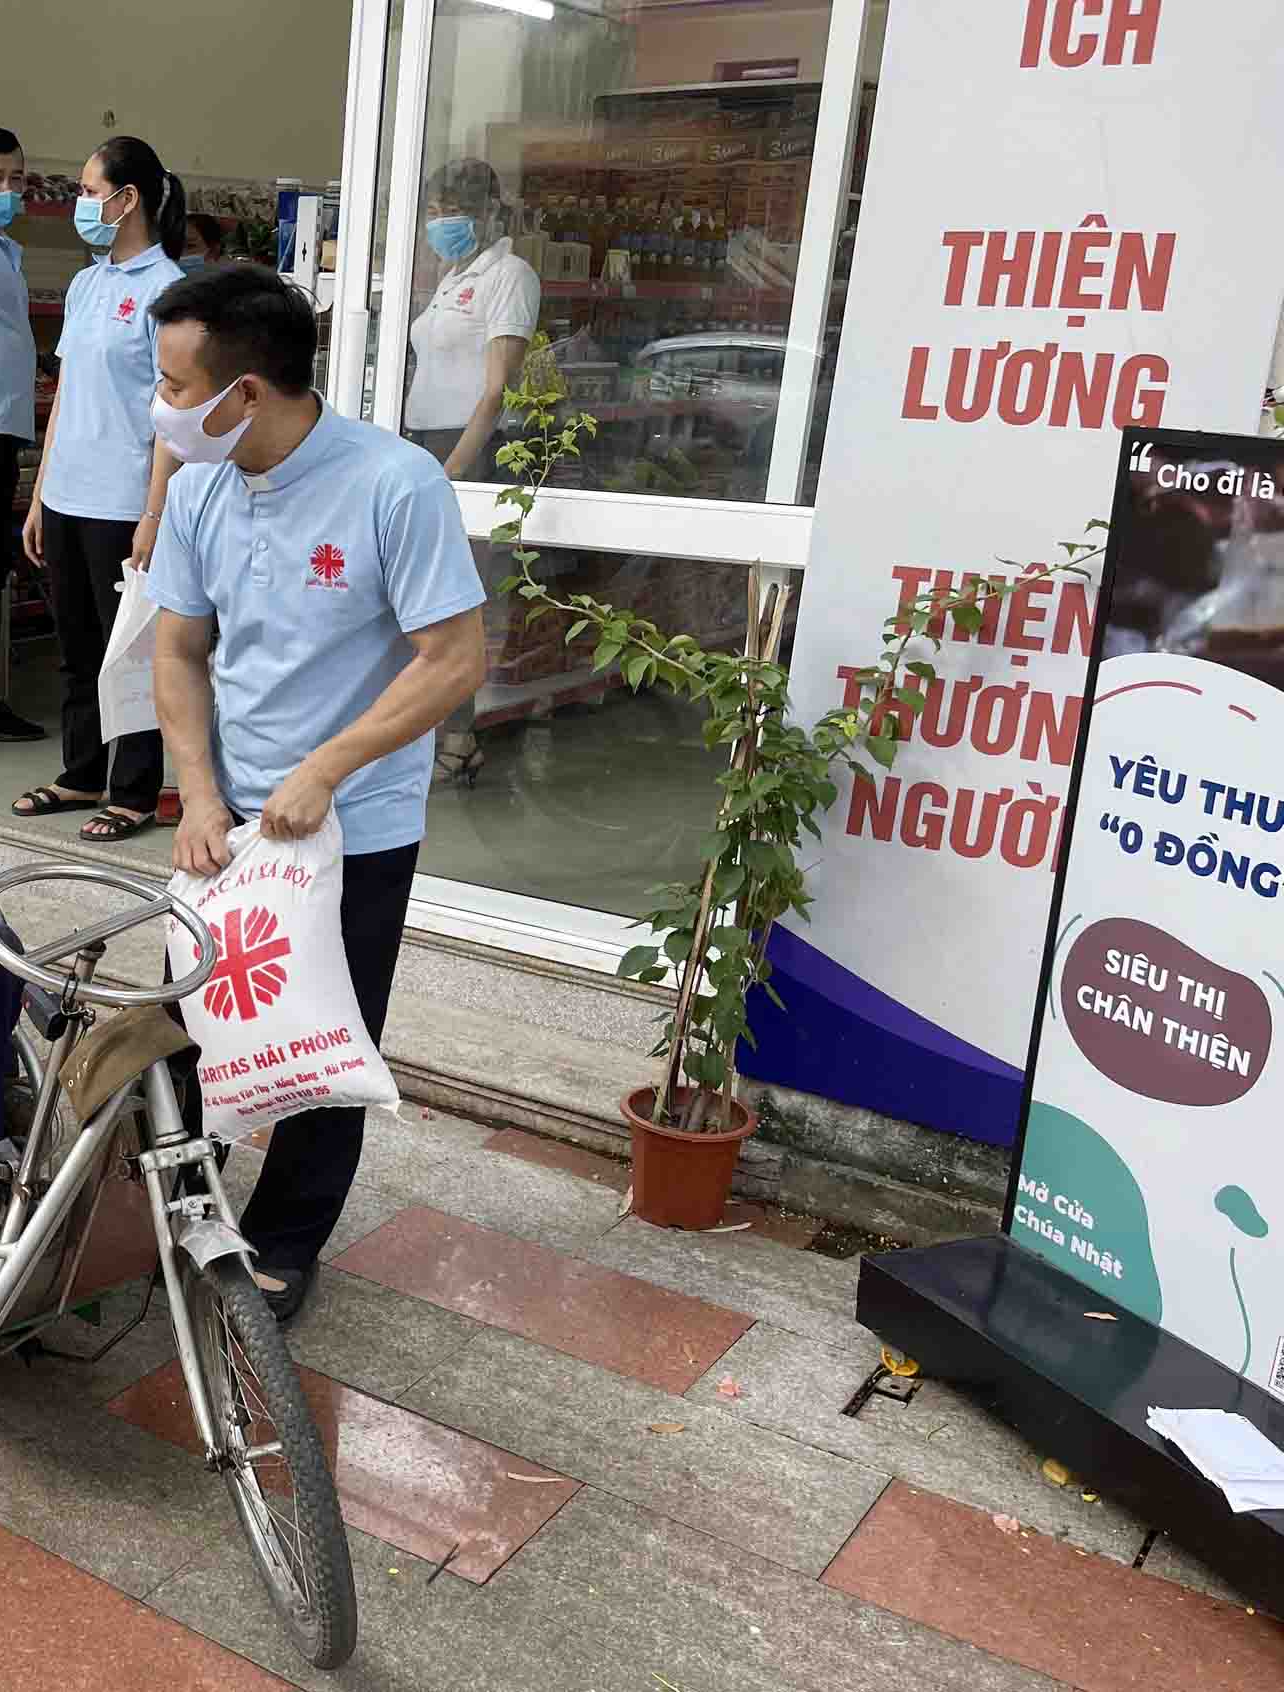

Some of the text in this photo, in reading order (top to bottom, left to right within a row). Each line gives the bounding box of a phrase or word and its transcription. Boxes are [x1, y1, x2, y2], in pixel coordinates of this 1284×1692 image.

[942, 214, 1177, 328] THIỆN
[901, 340, 1170, 430] LƯƠNG
[1157, 464, 1210, 492] Cho
[1217, 468, 1245, 496] đi
[1251, 471, 1276, 499] là
[892, 562, 1100, 667] THIỆN
[1109, 755, 1188, 804] YÊU
[1105, 949, 1227, 1021] SIÊU THỊ
[253, 1043, 287, 1071] HẢI
[289, 1026, 352, 1059] PHÒNG
[1076, 984, 1252, 1077] CHÂN THIỆN
[1018, 1174, 1094, 1230] Mở Cửa
[1014, 1204, 1124, 1280] Chúa Nhật
